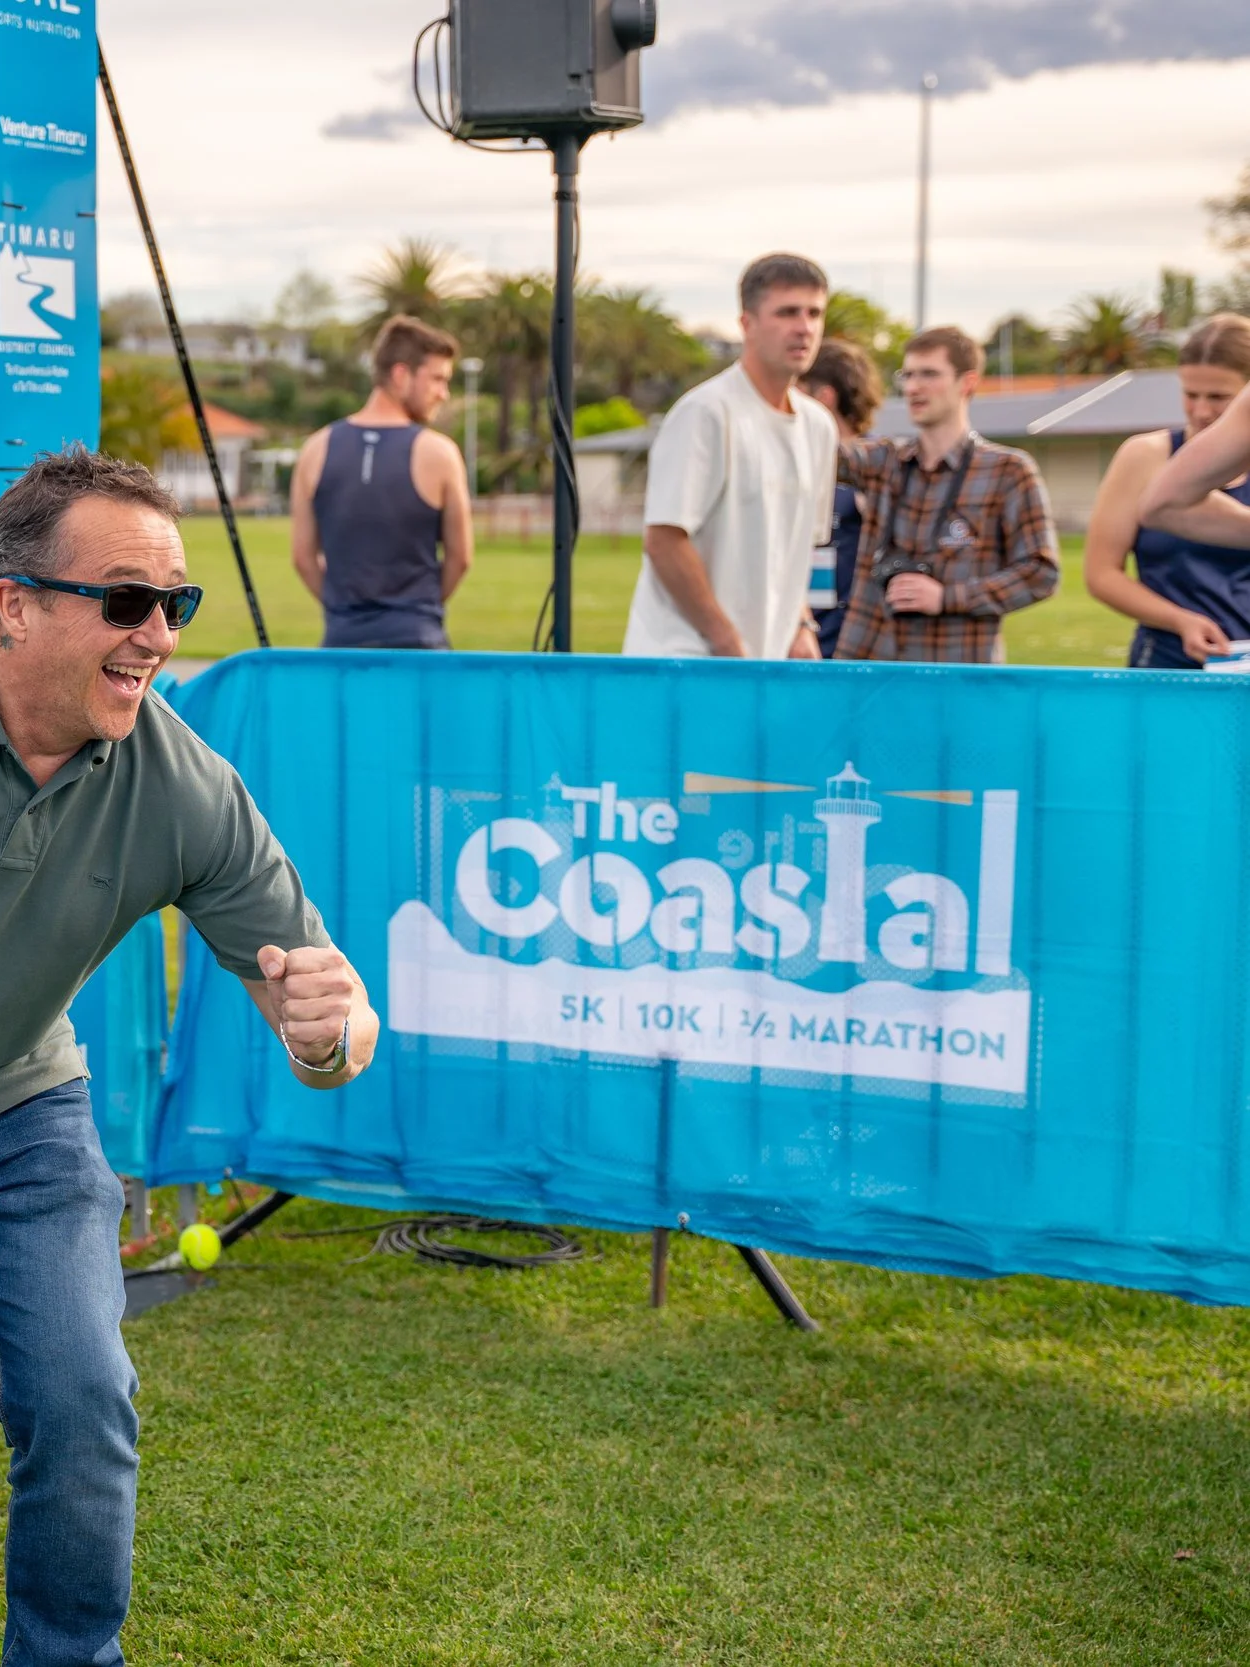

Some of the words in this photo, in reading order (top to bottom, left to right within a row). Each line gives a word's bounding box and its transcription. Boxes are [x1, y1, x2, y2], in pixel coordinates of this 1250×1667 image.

[25, 18, 81, 40] NUTRITION
[0, 115, 47, 141] Venture
[46, 122, 87, 147] Timaru
[561, 781, 679, 845] The
[560, 994, 605, 1025] 5K
[636, 1002, 701, 1033] 10K
[790, 1013, 1005, 1061] MARATHON
